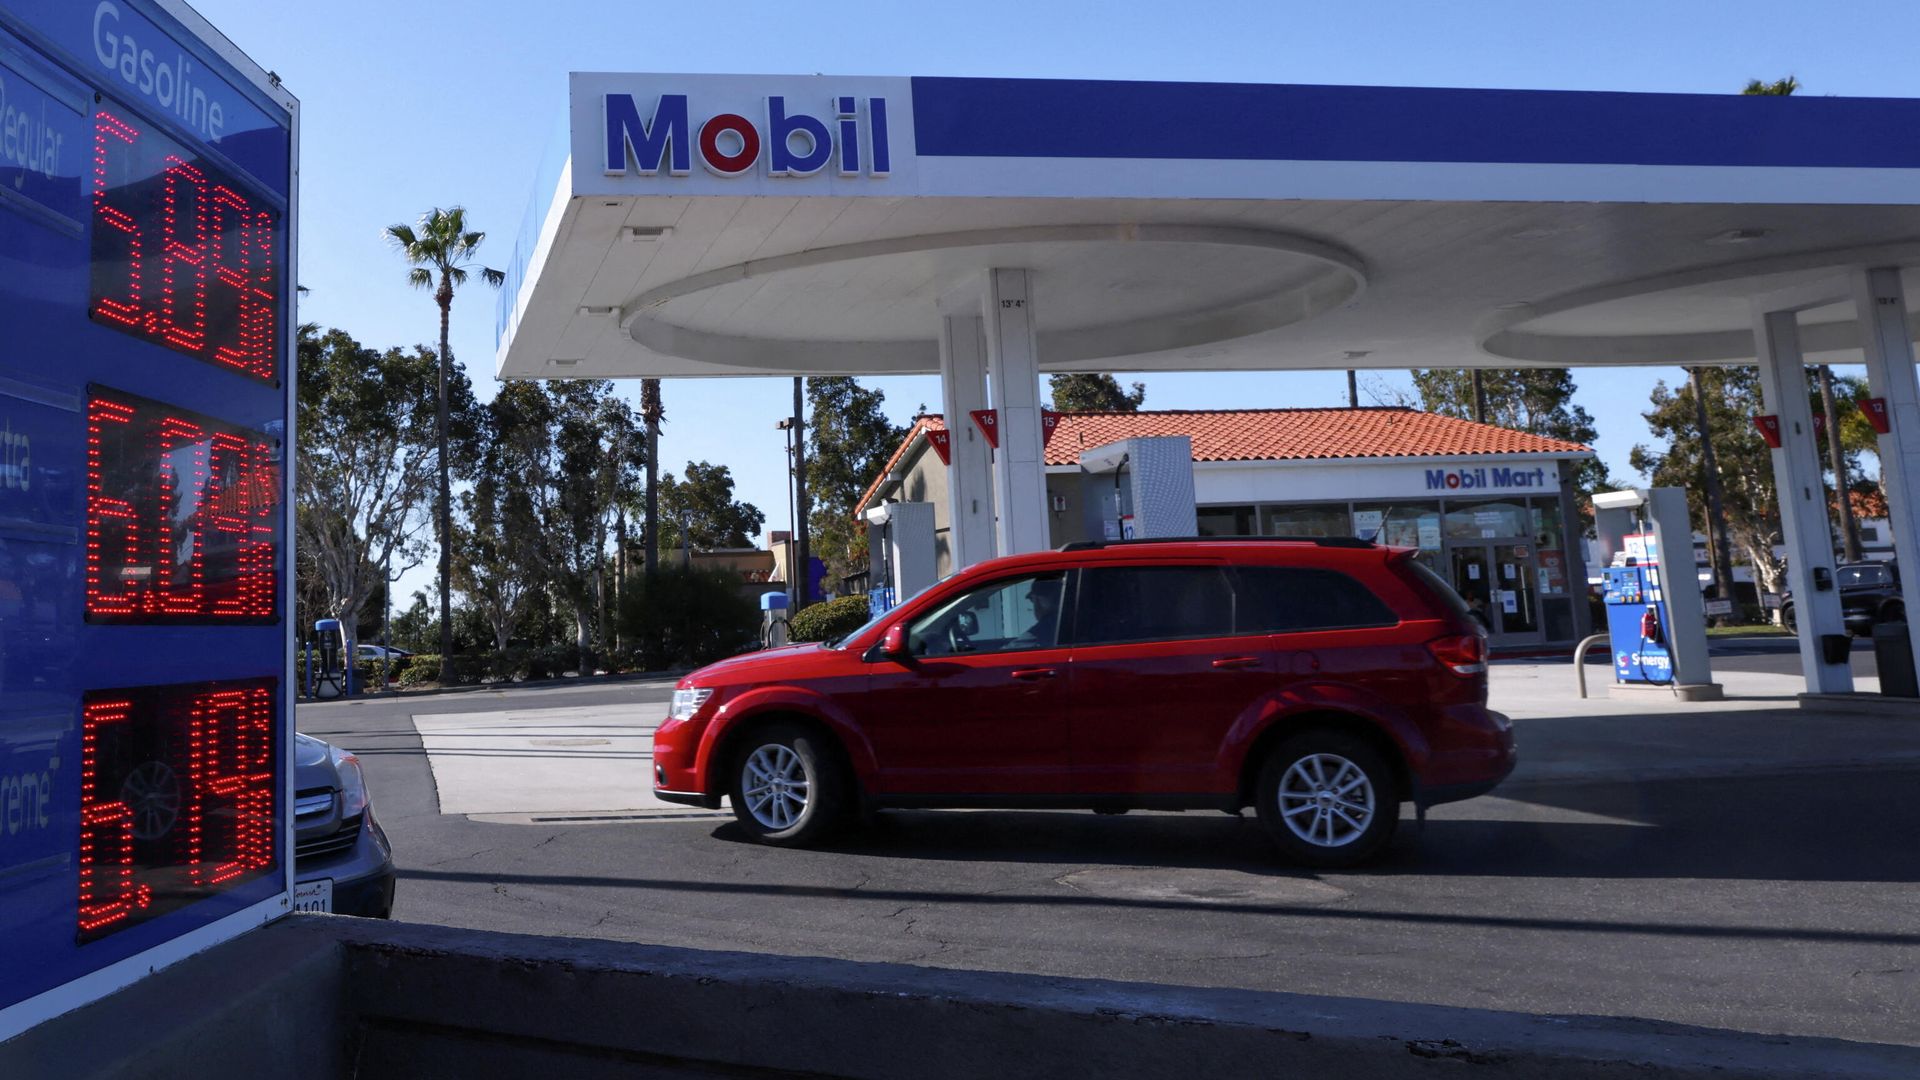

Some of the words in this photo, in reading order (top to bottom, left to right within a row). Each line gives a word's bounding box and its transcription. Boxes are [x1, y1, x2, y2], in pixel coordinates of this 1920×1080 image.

[93, 3, 225, 143] Gasoline
[602, 93, 891, 178] Mobil
[935, 434, 947, 444] 14
[982, 415, 994, 425] 16
[1043, 417, 1055, 427] 15
[1425, 468, 1487, 490] Mobil
[1491, 467, 1544, 487] Mart
[87, 399, 248, 614] 6.09
[79, 690, 247, 929] 6.19
